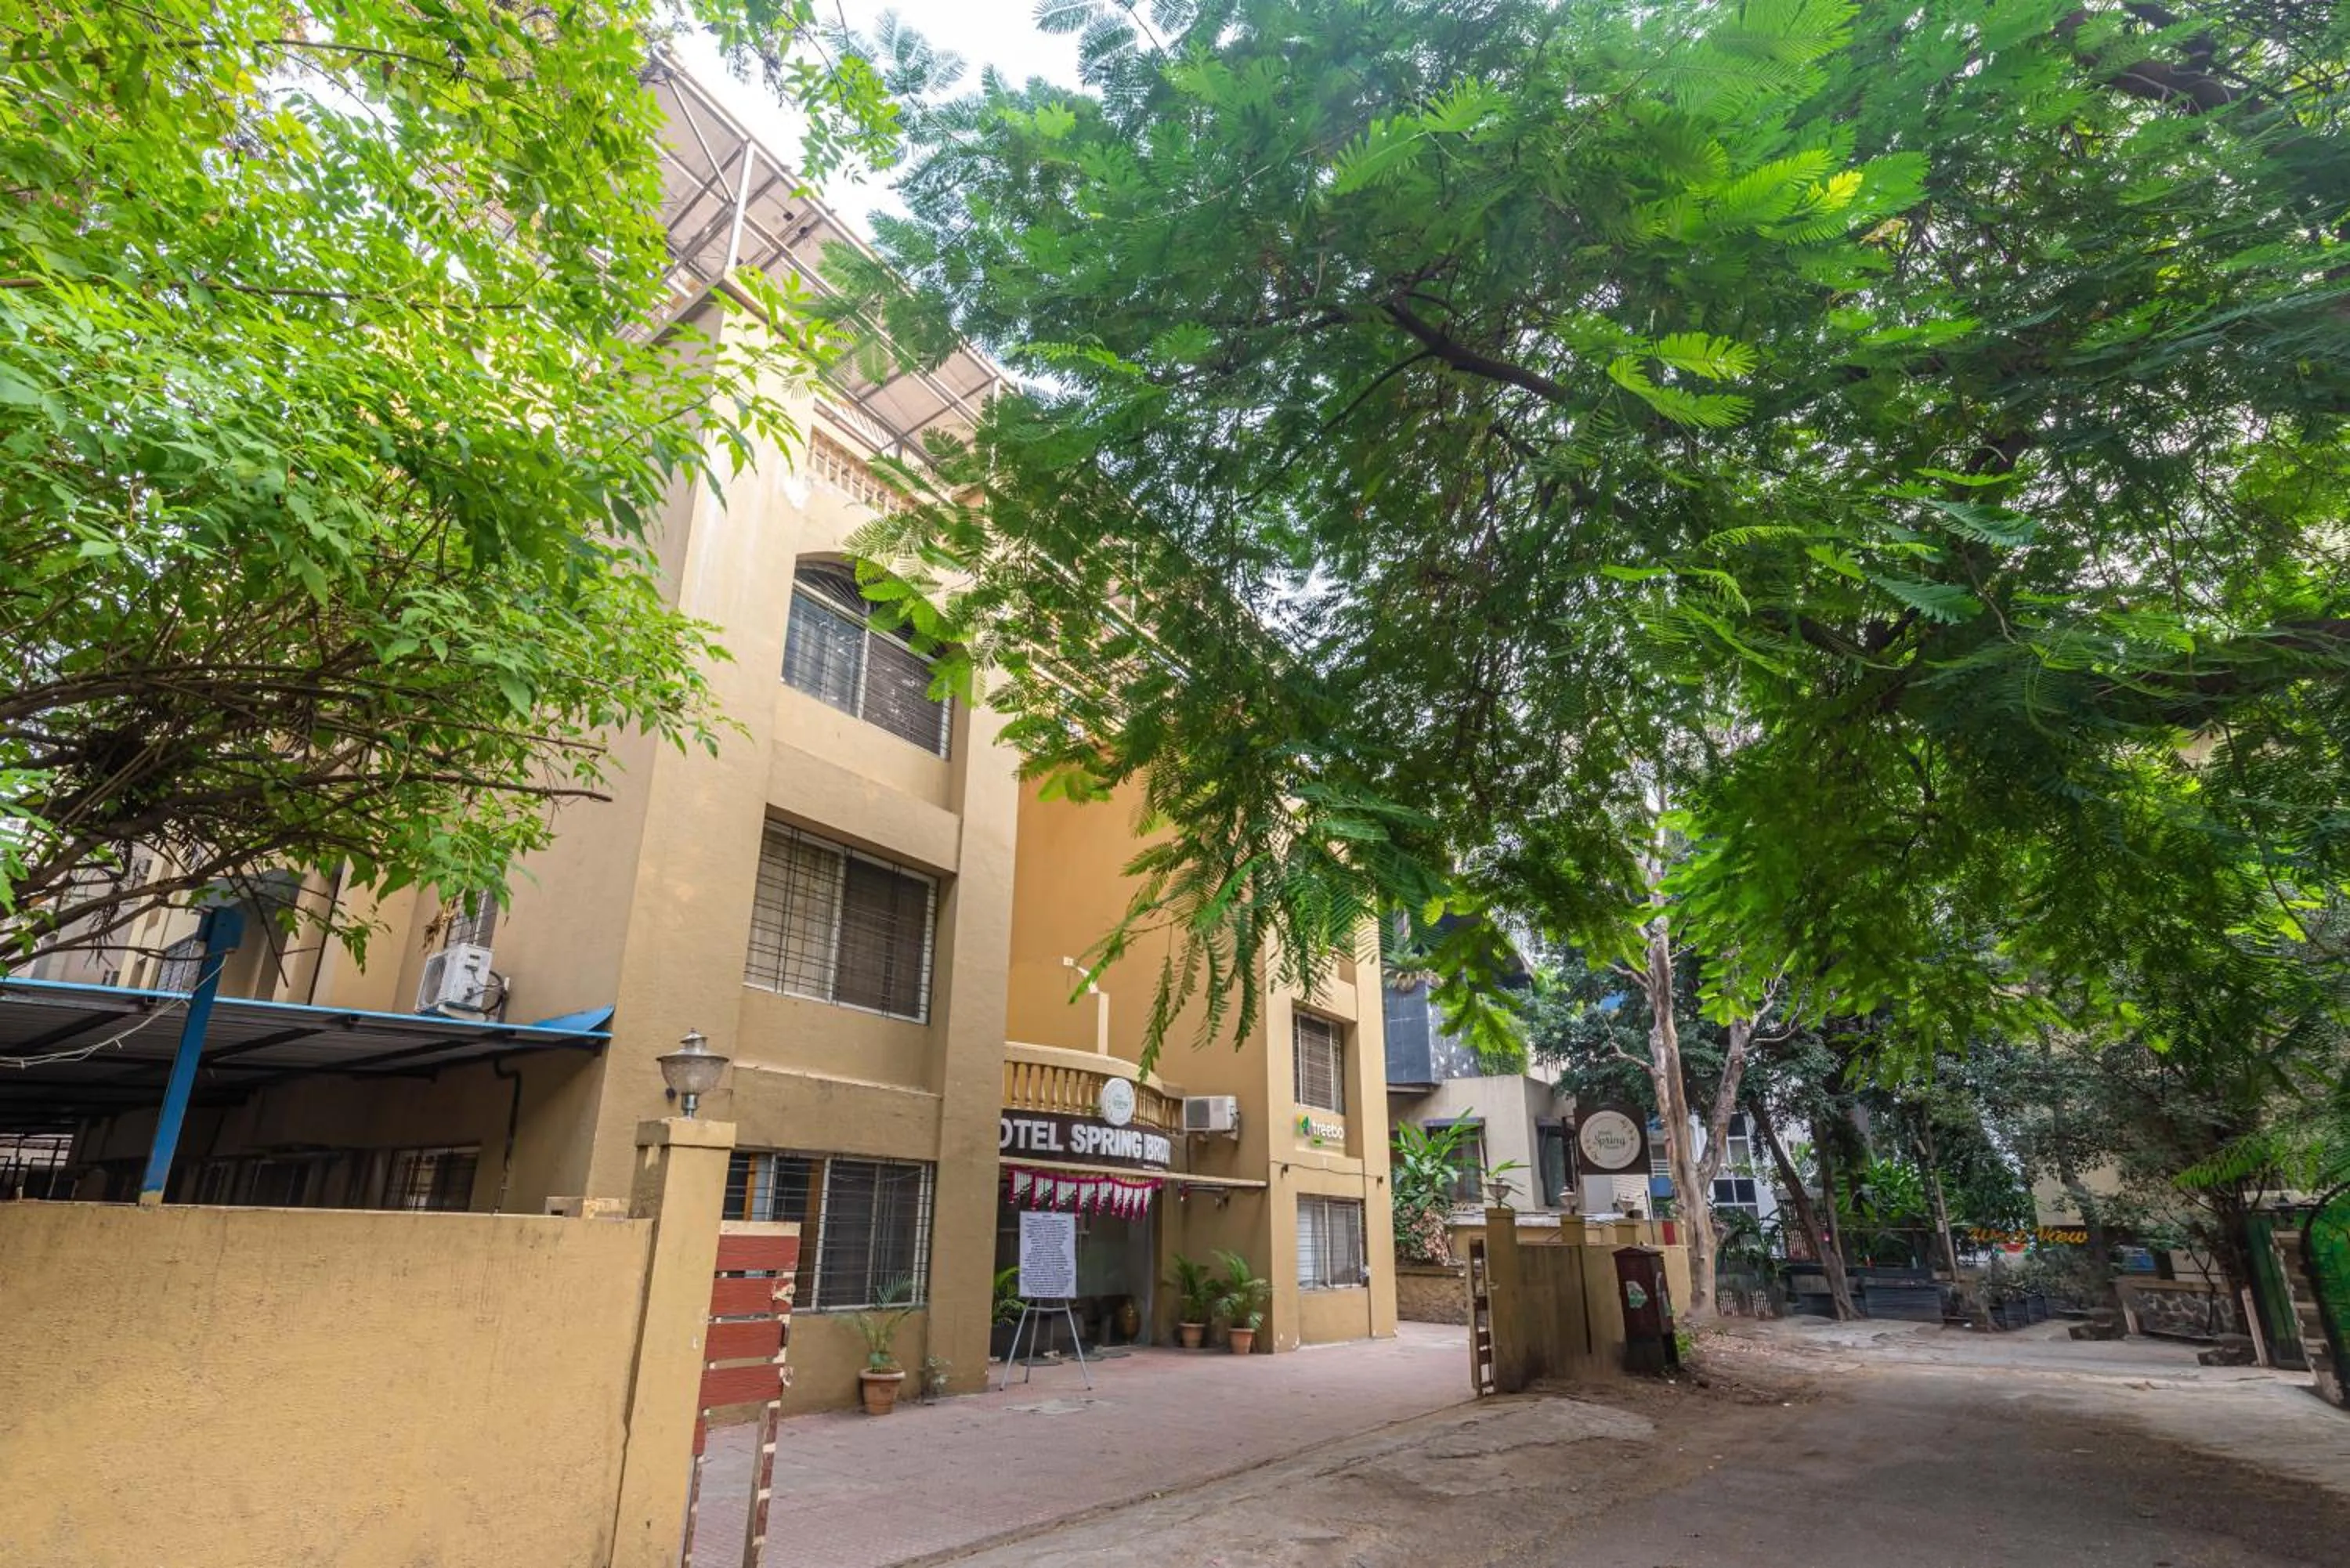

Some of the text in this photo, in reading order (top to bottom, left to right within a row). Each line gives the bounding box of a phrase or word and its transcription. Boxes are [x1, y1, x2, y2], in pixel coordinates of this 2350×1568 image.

[1000, 1118, 1064, 1151] OTEL
[1069, 1123, 1143, 1158] SPRING
[1312, 1120, 1345, 1140] treebo
[2034, 1226, 2088, 1244] View
